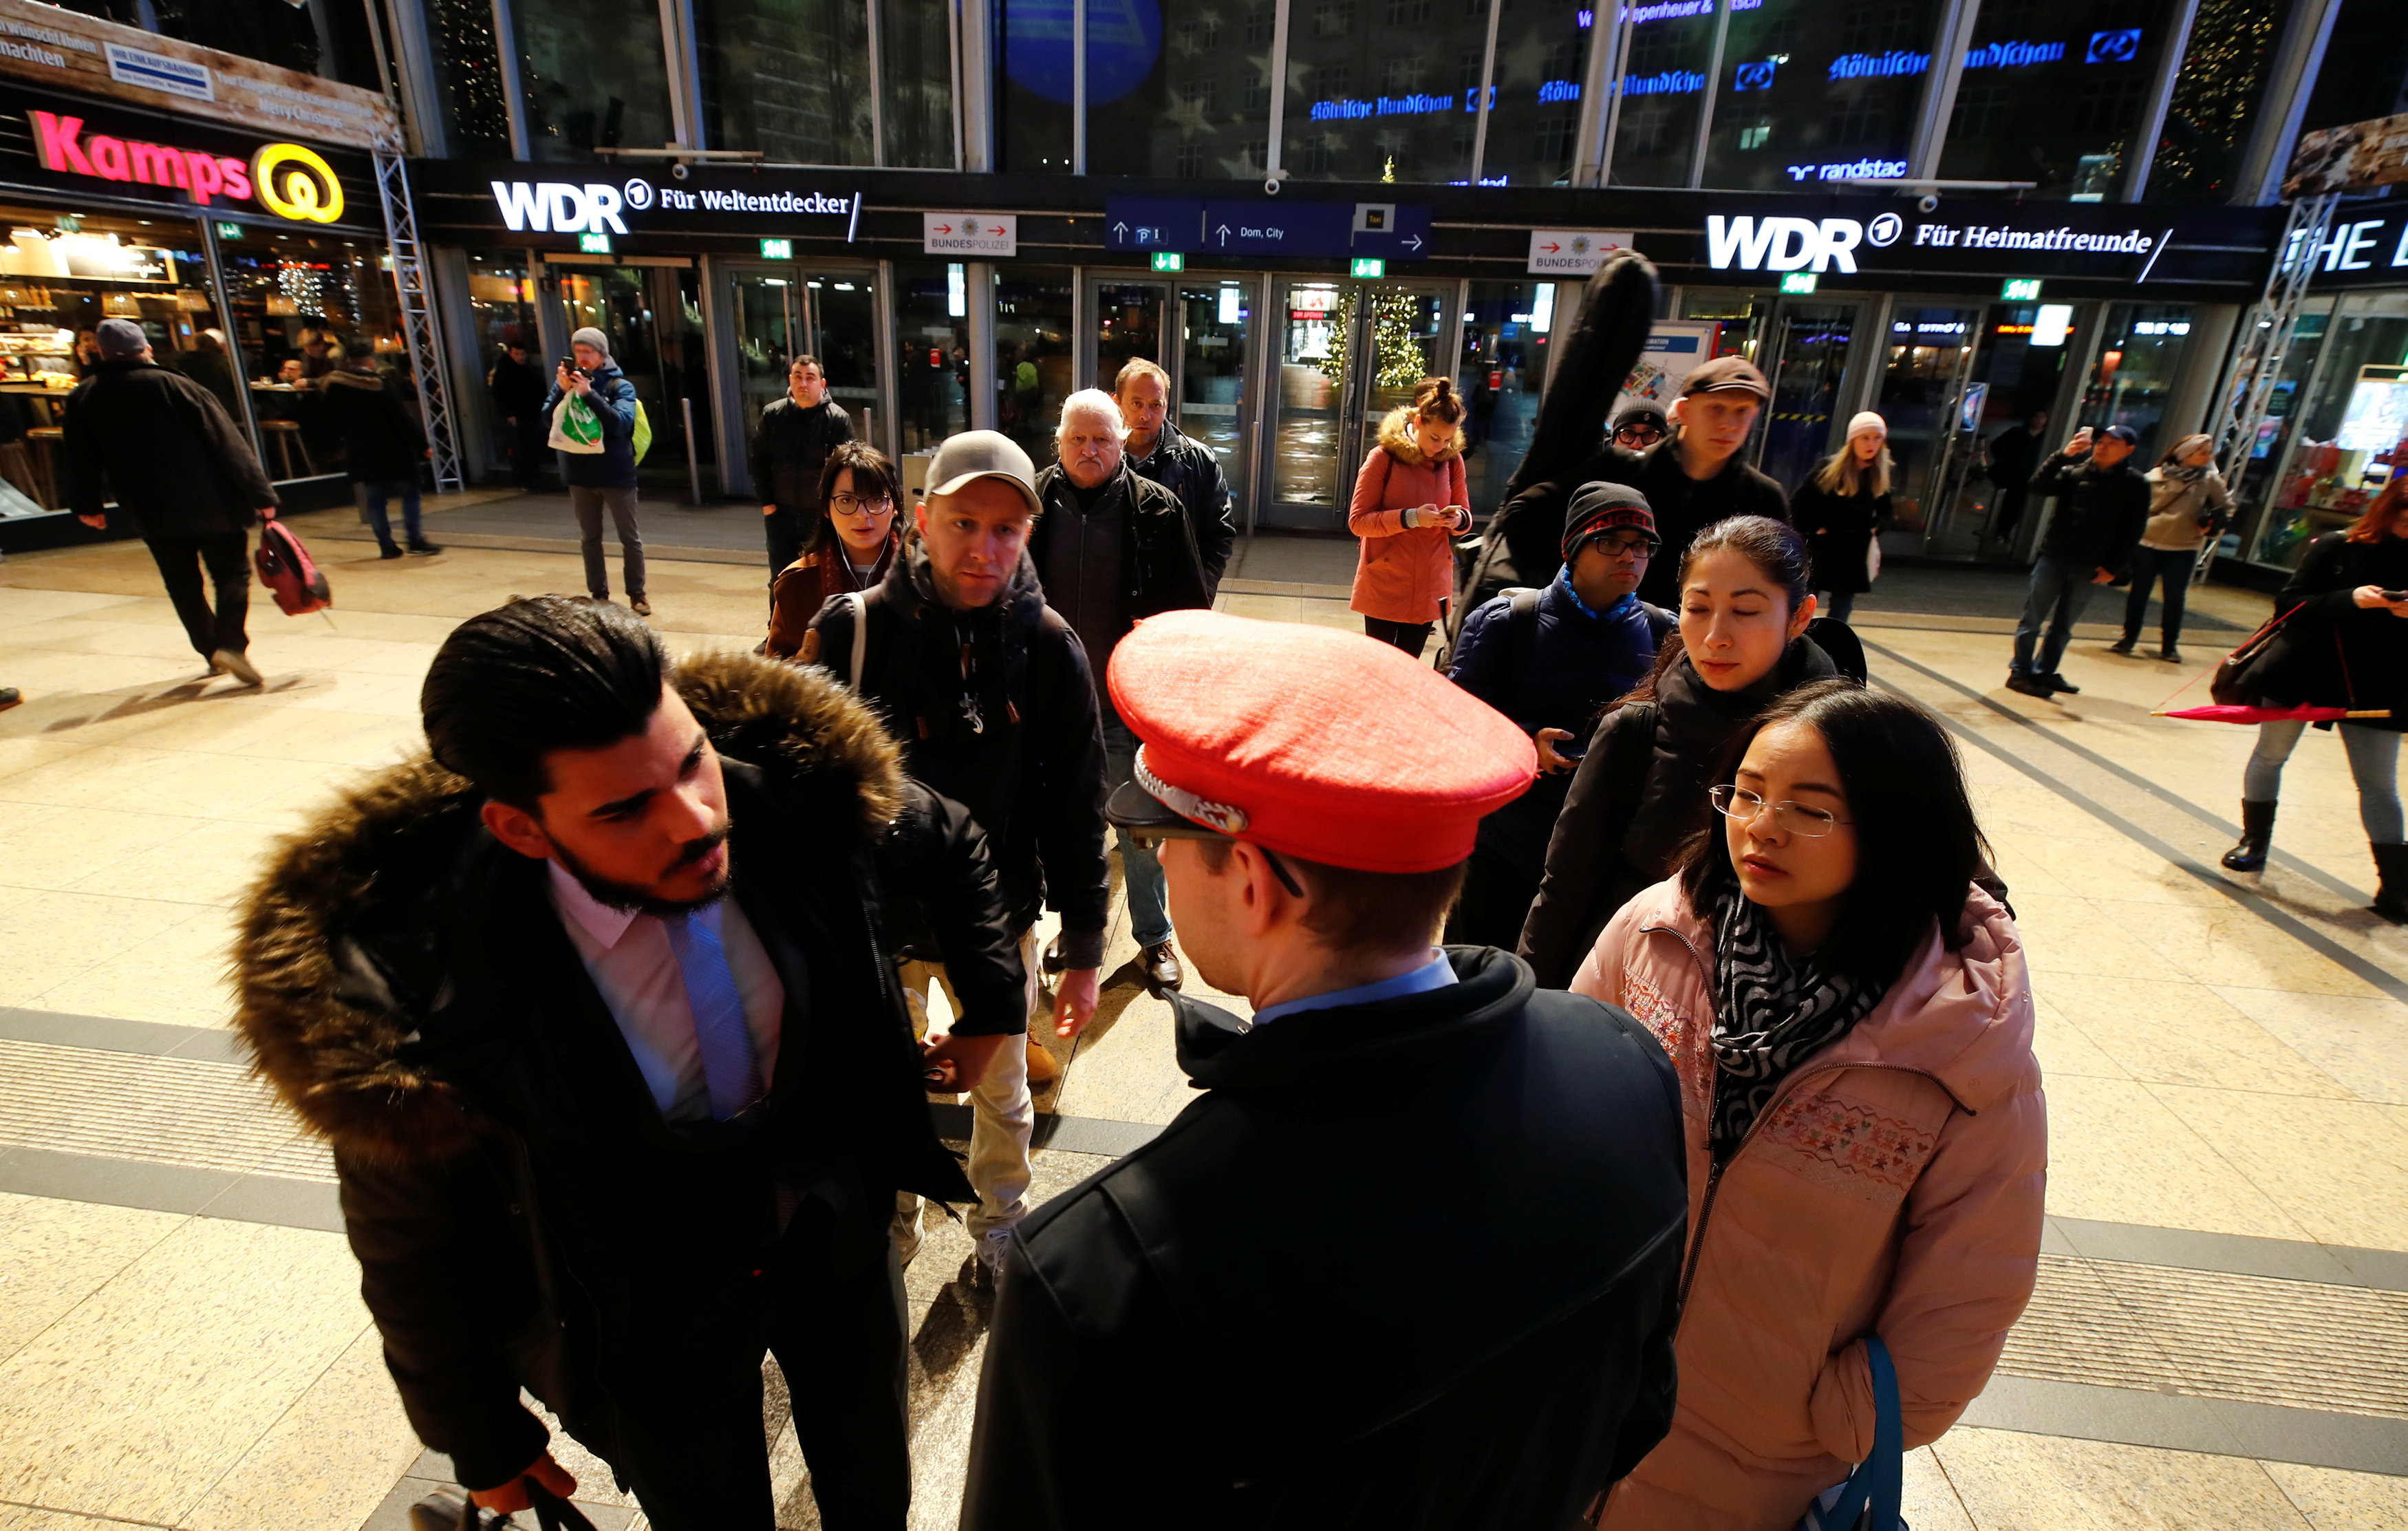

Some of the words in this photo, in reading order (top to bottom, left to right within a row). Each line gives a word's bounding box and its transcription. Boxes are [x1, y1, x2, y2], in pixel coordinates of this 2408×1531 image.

[36, 111, 253, 205] Kamps
[491, 181, 630, 235] WDR
[660, 189, 697, 210] Für
[699, 189, 849, 214] Weltentdecker
[1240, 227, 1264, 239] Dom,
[1266, 228, 1284, 239] City
[932, 239, 1009, 250] BUNDESPOLIZEI
[1707, 215, 1863, 274] WDR
[1915, 224, 1960, 246] Für
[1964, 226, 2152, 254] Heimatfreunde
